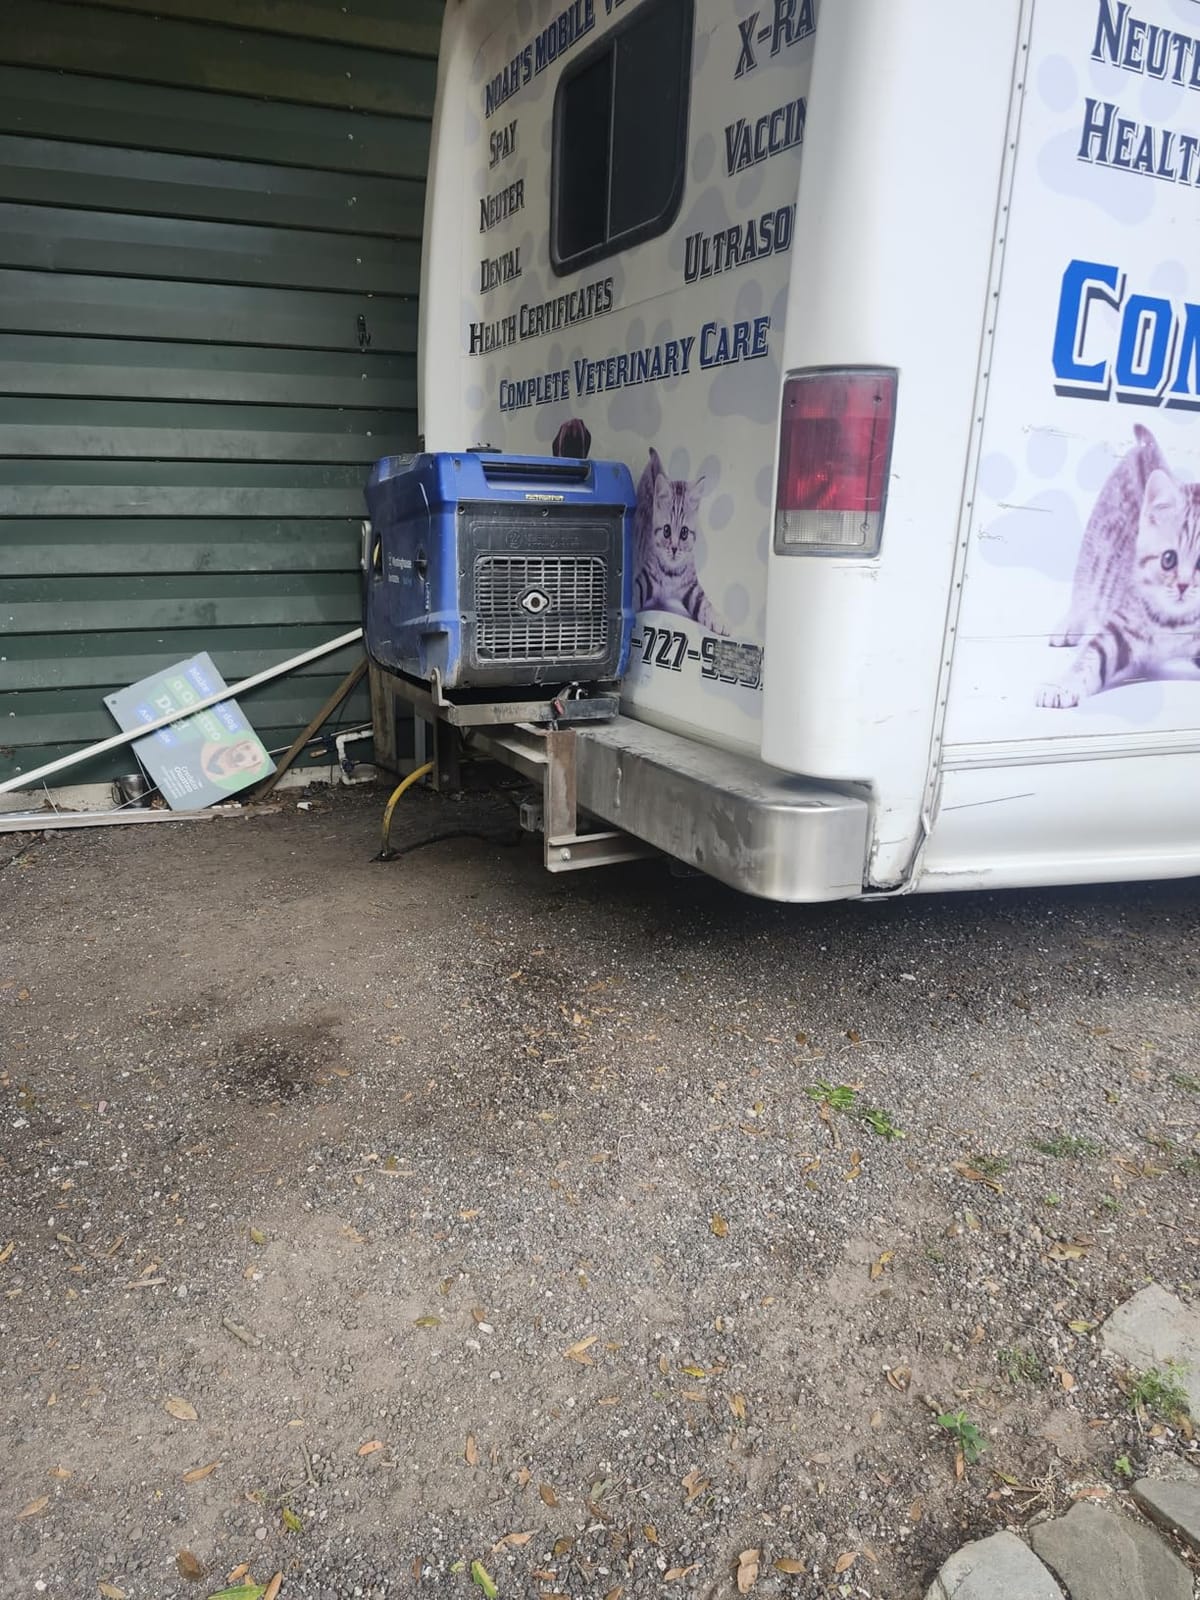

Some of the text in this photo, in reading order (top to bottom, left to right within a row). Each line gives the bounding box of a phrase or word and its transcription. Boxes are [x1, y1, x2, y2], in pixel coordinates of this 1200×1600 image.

[485, 0, 596, 119] NOAH'S MOBILE
[733, 0, 817, 80] X-RA
[489, 119, 518, 170] SPAY
[1077, 97, 1200, 188] HEALT
[479, 178, 525, 234] NEUTER
[684, 203, 797, 284] ULTRASO
[479, 247, 522, 295] DENTAL
[468, 277, 615, 357] HEALTH CERTIFICATES
[499, 315, 771, 413] COMPLETE VETERINARY CARE
